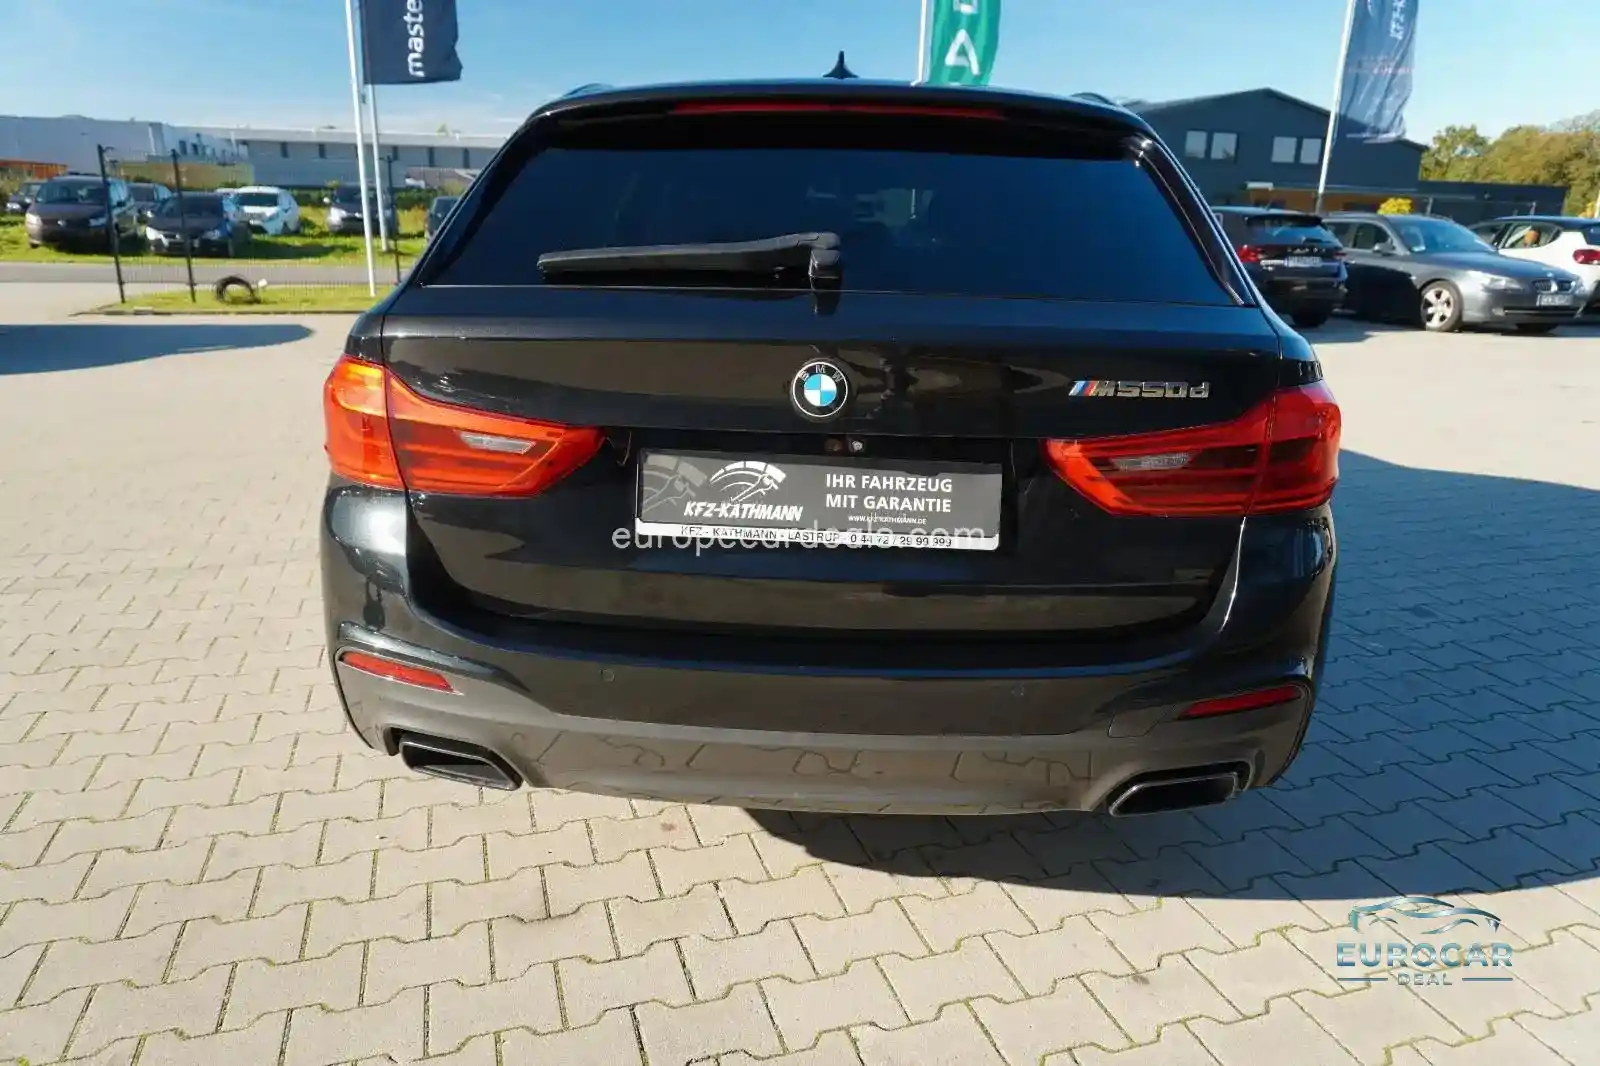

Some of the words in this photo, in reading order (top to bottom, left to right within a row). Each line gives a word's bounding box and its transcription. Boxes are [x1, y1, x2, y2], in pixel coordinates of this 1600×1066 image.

[1091, 380, 1211, 398] M550d
[826, 473, 856, 488] IHR
[861, 475, 953, 493] FAHRZEUG
[683, 501, 804, 522] KFZ-KATHMANN
[825, 493, 858, 509] MIT
[863, 495, 952, 513] GARANTIE
[712, 528, 778, 540] KATHMANN
[788, 532, 839, 542] LASTRUP
